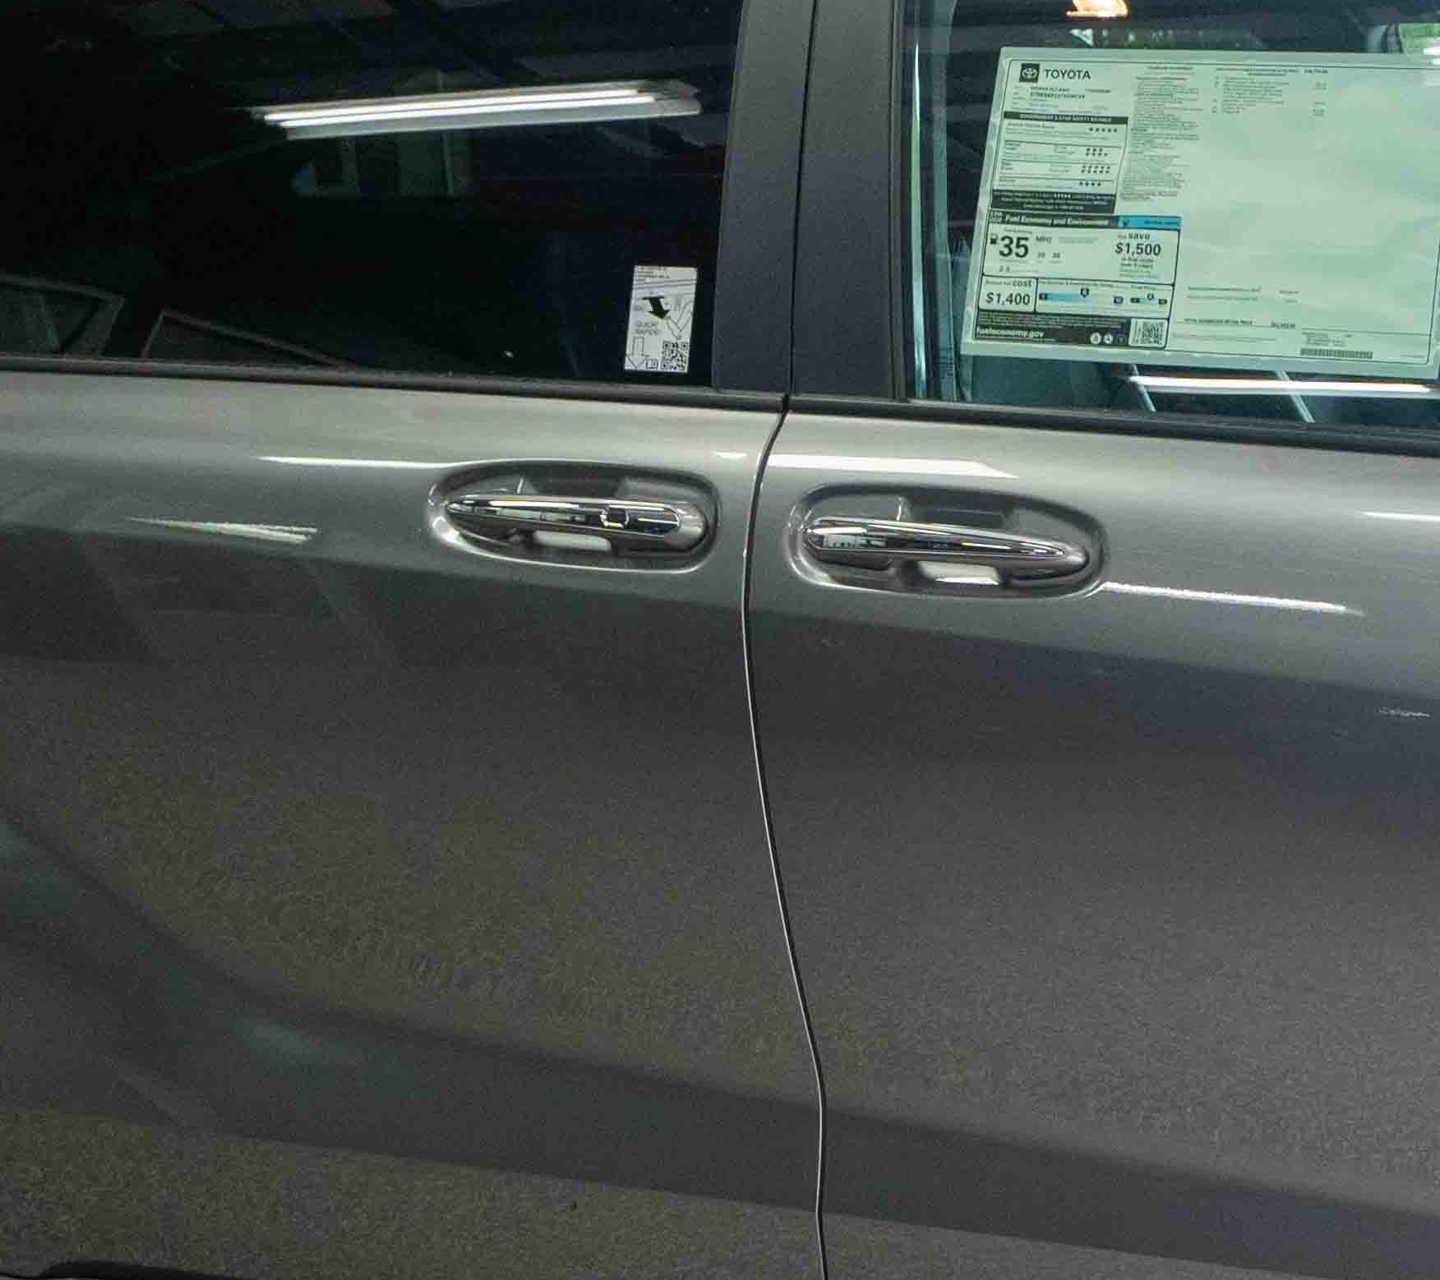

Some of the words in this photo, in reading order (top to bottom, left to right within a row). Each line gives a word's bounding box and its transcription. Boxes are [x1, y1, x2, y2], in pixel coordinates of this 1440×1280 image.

[1044, 69, 1091, 81] TOYOTA
[1005, 215, 1020, 224] Fuel
[998, 235, 1029, 259] 35
[1115, 242, 1162, 256] $1,500
[1012, 280, 1033, 288] cost
[985, 292, 1031, 306] $1,400
